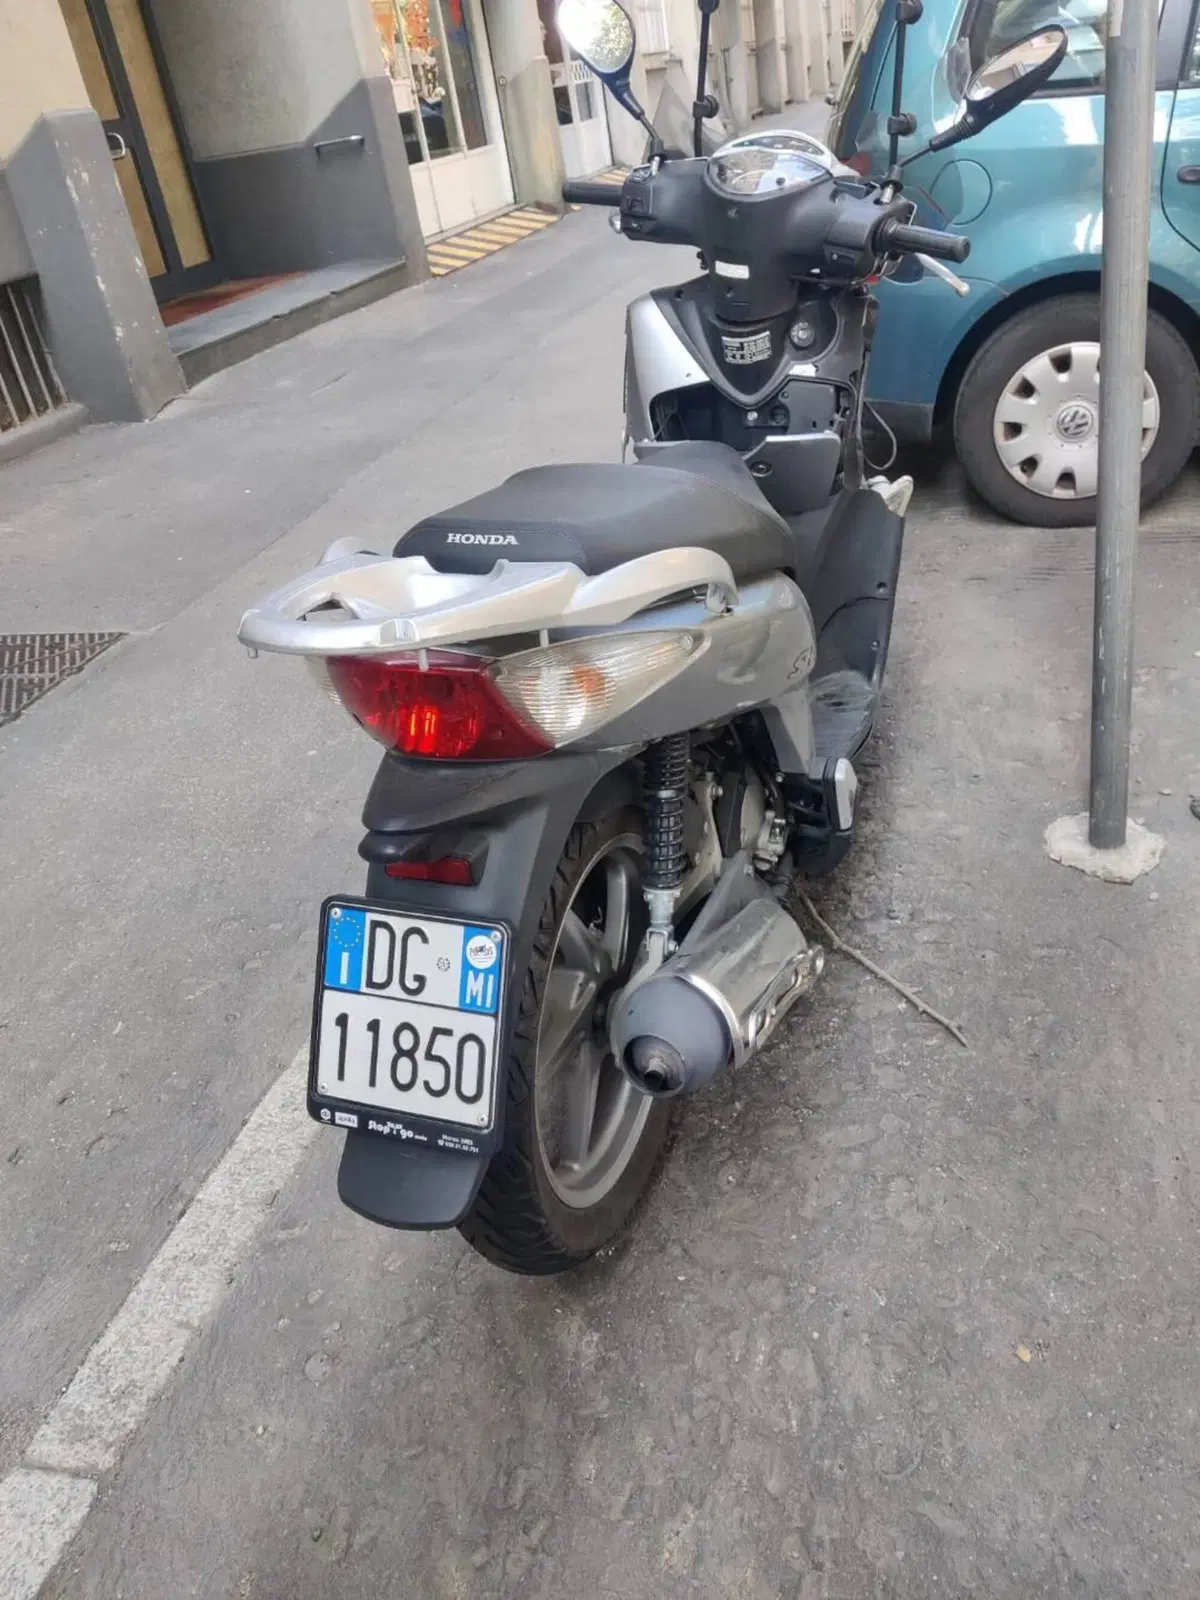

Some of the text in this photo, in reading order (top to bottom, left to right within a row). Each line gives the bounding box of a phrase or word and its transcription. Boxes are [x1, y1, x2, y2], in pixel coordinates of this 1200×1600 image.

[446, 532, 519, 546] HONDA
[339, 951, 350, 985] I
[365, 919, 430, 997] DG
[465, 970, 495, 1009] MI
[334, 1012, 487, 1105] 11850
